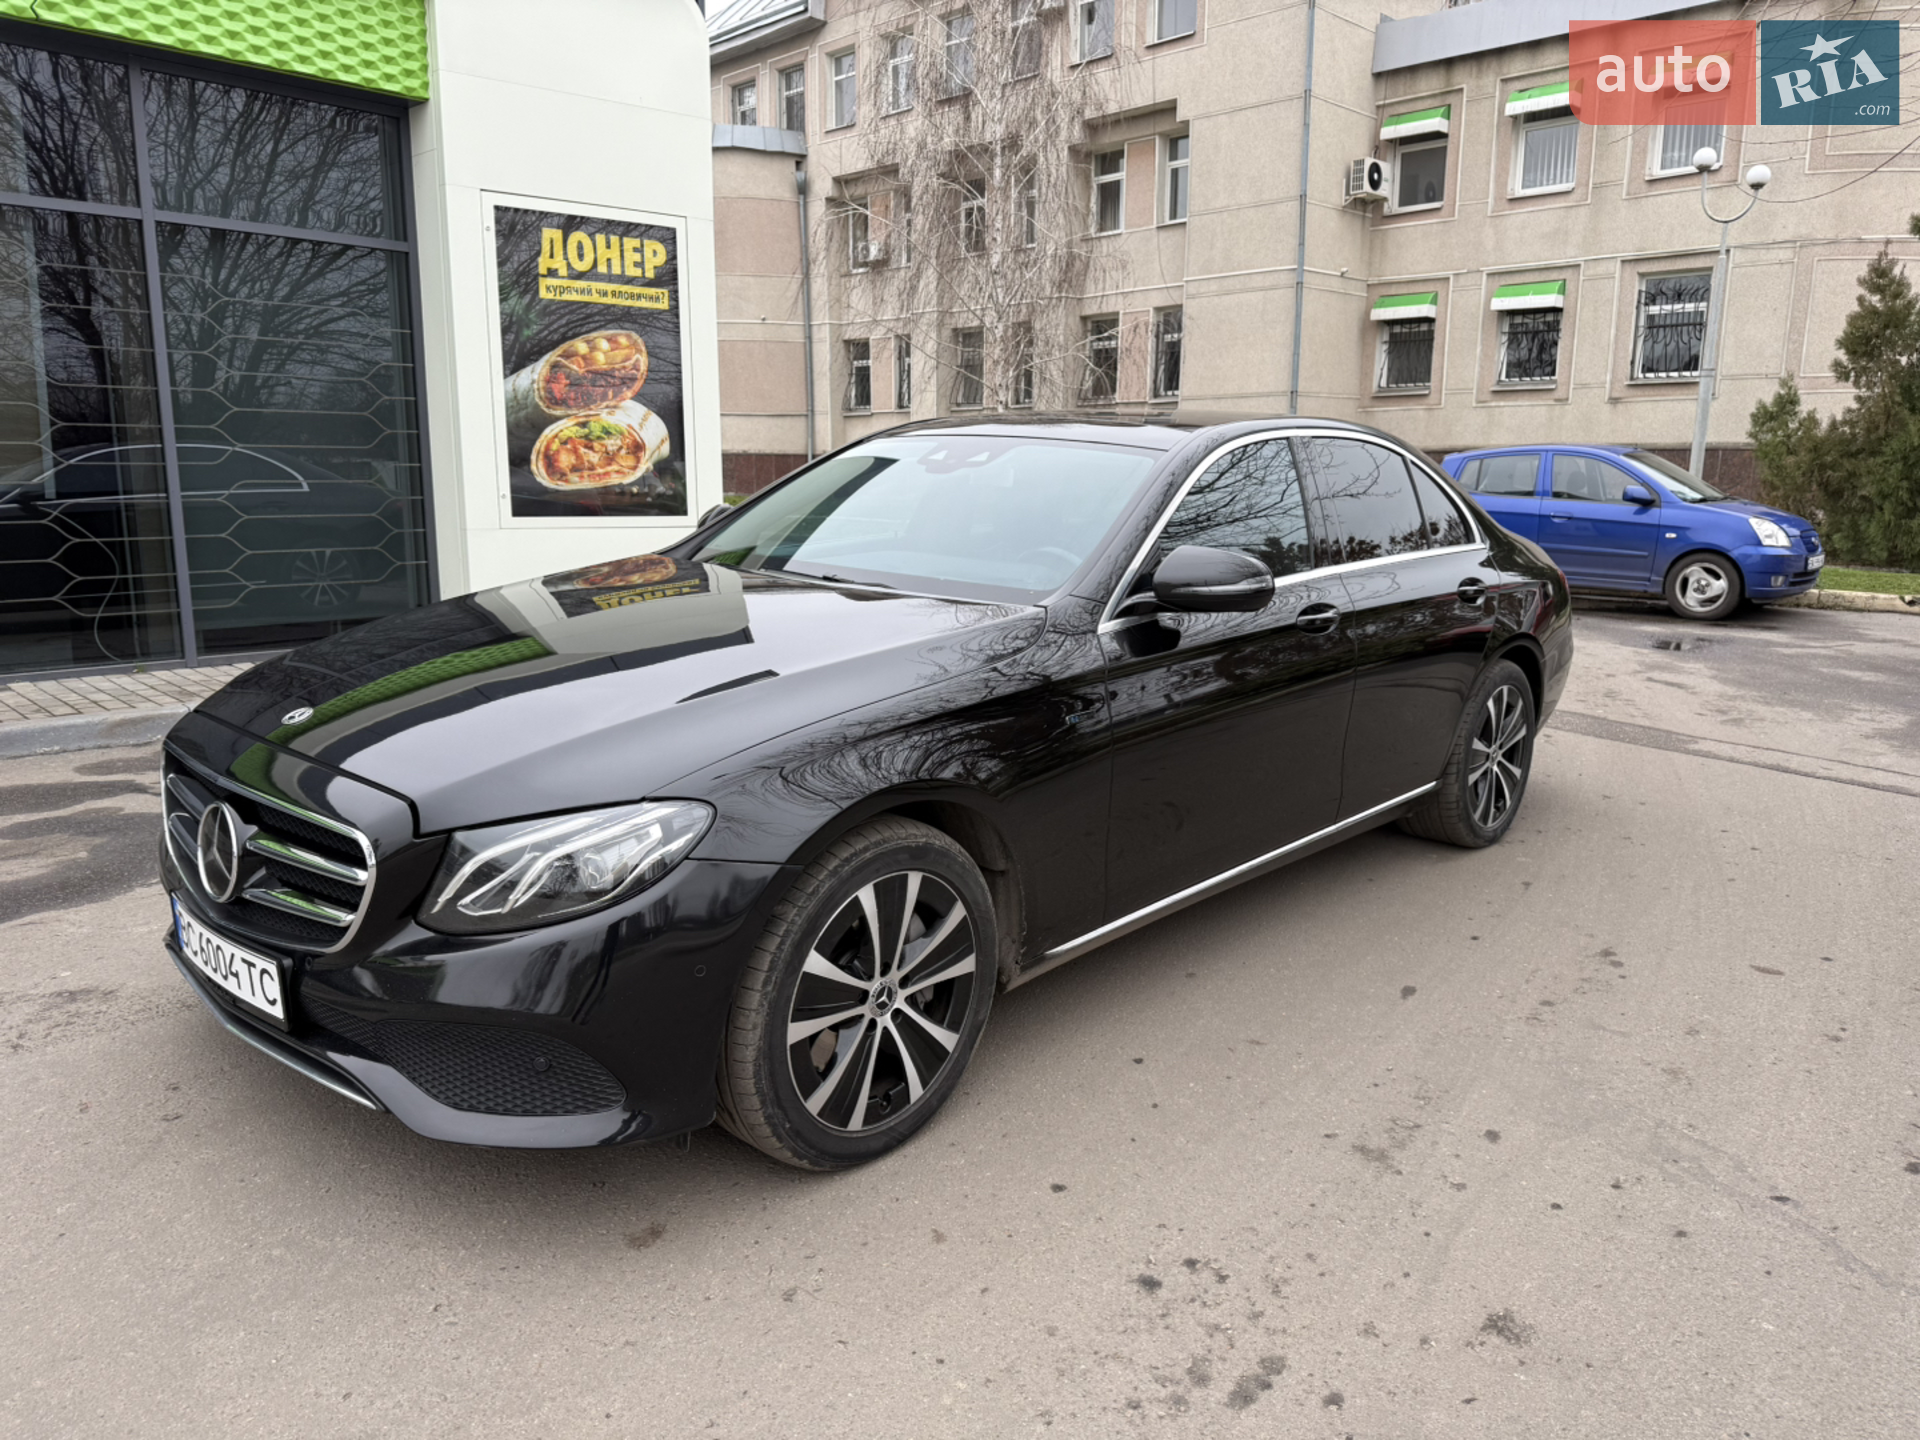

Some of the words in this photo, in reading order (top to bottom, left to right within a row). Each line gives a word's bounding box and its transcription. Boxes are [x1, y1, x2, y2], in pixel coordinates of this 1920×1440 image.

[538, 228, 667, 279] ДОНЕР
[545, 284, 593, 297] курячий
[595, 288, 608, 299] чи
